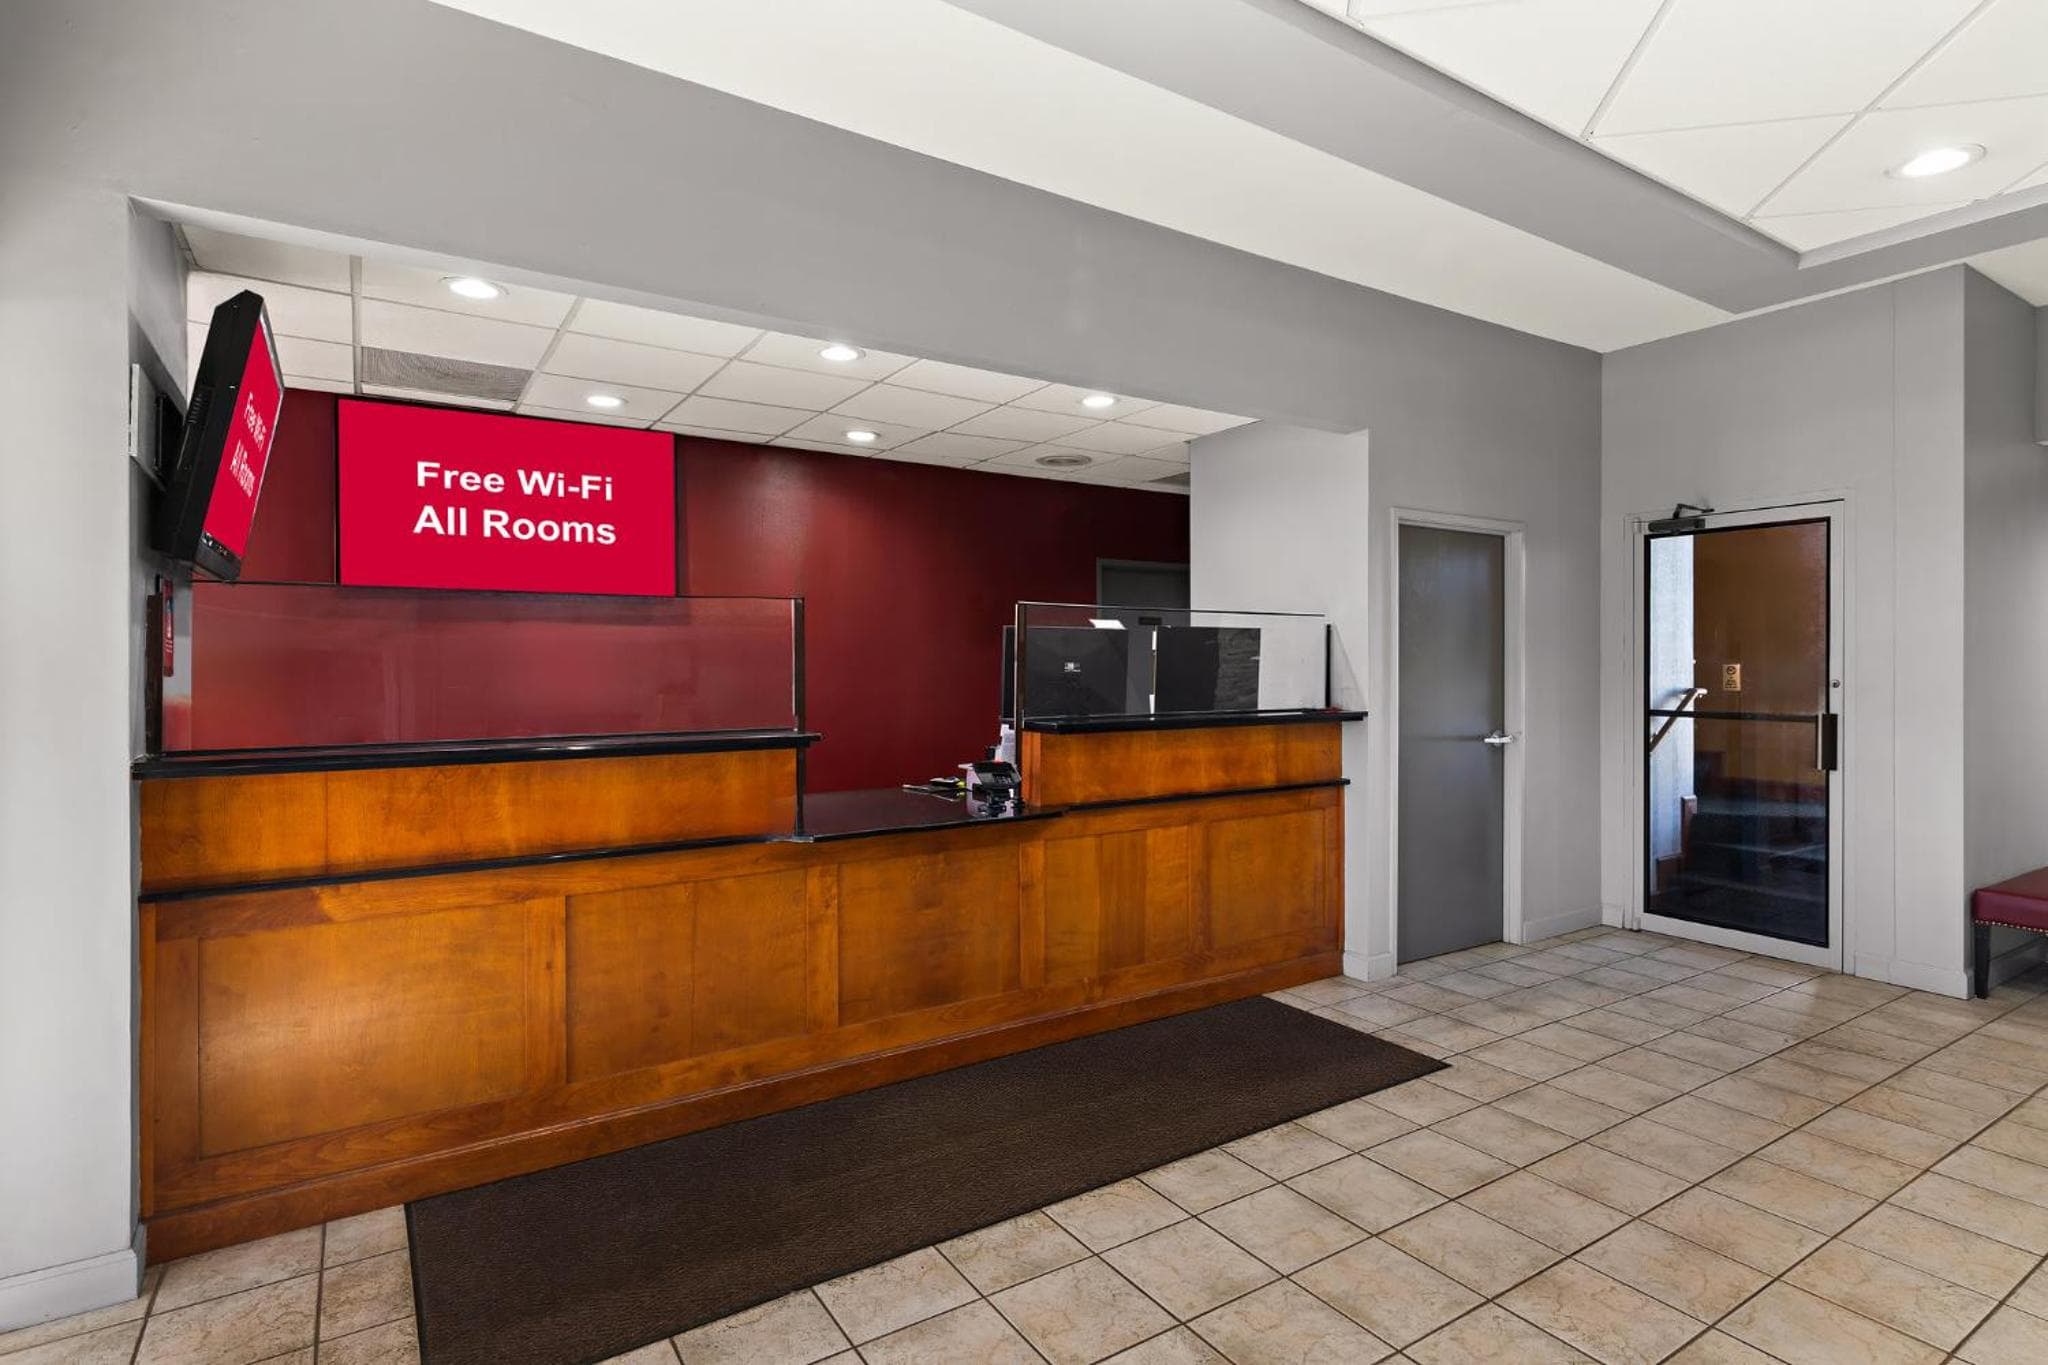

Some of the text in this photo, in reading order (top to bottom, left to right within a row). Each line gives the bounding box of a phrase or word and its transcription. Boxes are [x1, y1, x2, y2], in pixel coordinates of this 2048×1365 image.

[416, 461, 613, 501] Free Wi-Fi
[413, 504, 617, 545] All Rooms
